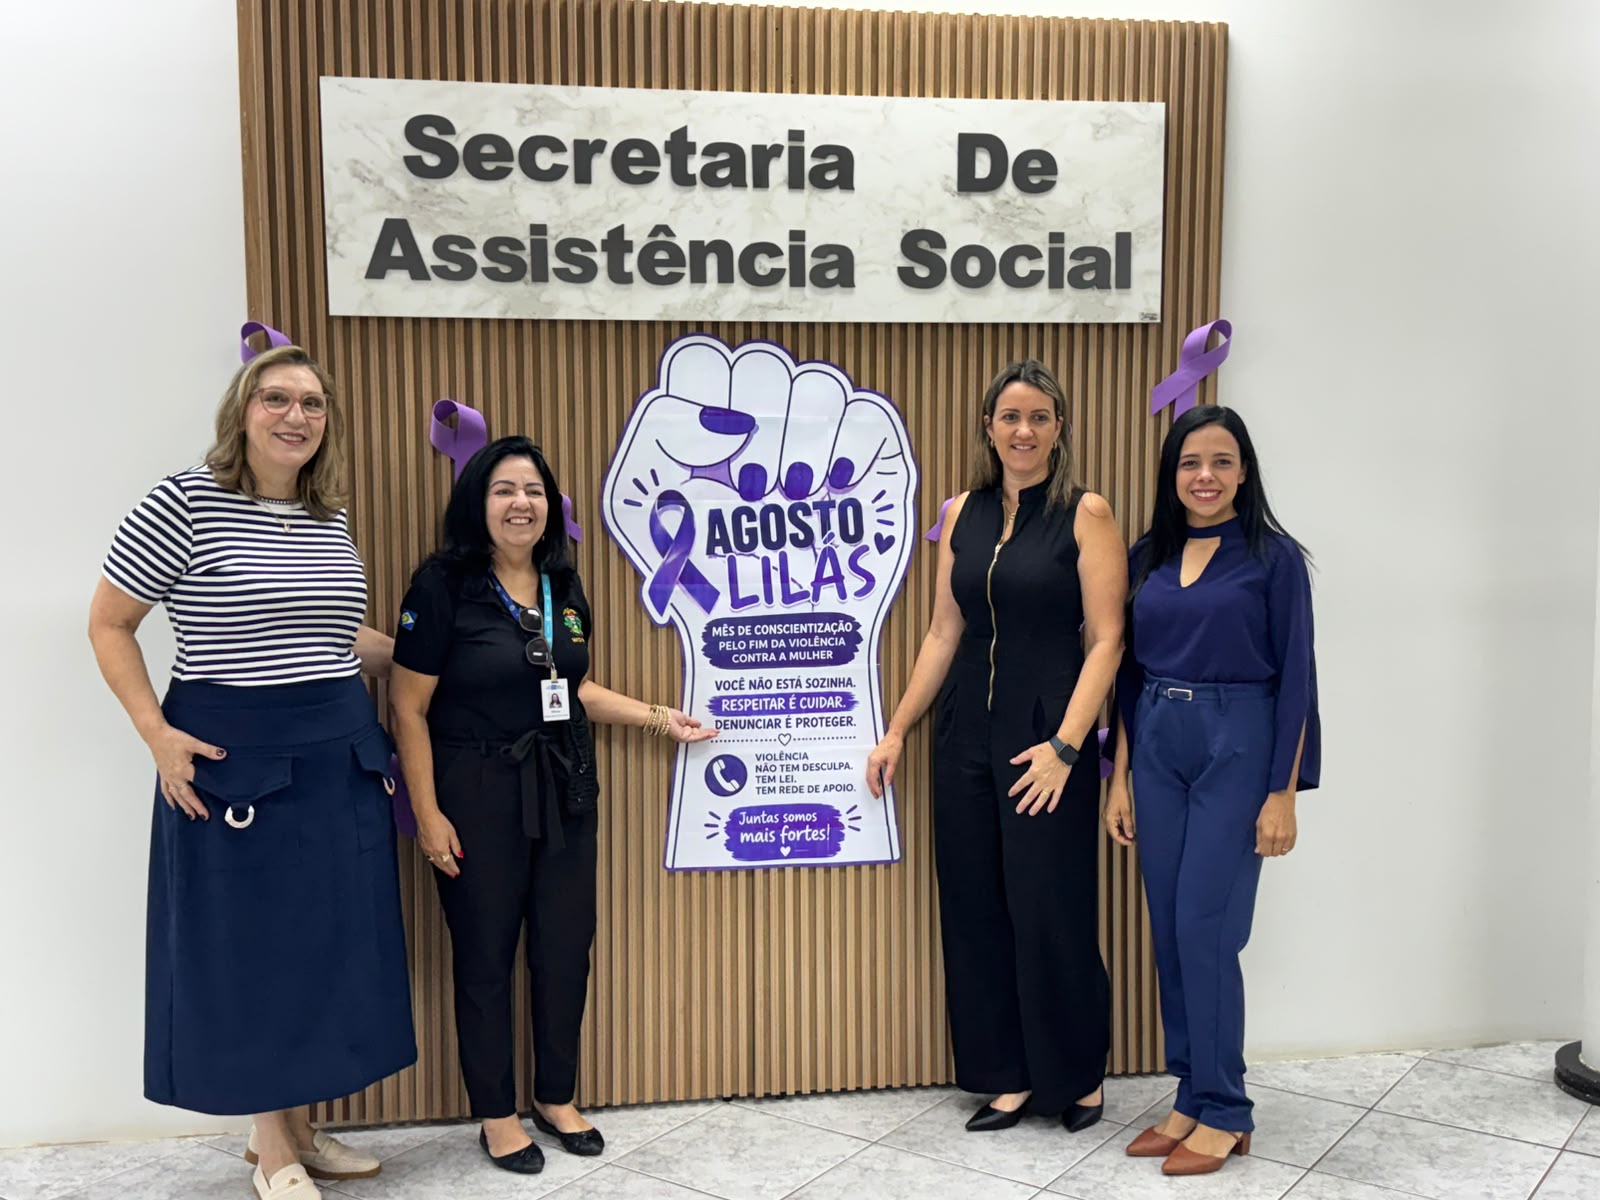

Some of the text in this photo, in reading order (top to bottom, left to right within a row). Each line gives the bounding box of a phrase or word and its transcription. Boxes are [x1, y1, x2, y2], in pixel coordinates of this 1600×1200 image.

[403, 114, 1059, 194] Secretaria De
[364, 218, 1133, 291] Assistência Social
[706, 498, 864, 555] AGOSTO
[727, 532, 876, 609] LILÁS
[712, 620, 852, 637] MÊS DE CONSCIENTIZAÇÃO
[719, 635, 846, 650] PELO FIM DA VIOLÊNCIA
[732, 651, 833, 663] CONTRA A MULHER
[715, 676, 856, 691] VOCÊ NÃO ESTÁ SOZINHA.
[722, 695, 846, 712] RESPEITAR É CUIDAR.
[715, 715, 856, 730] DENUNCIAR É PROTEGER.
[755, 751, 809, 761] VIOLÊNCIA
[755, 762, 853, 772] NÃO TEM DESCULPA.
[755, 775, 797, 784] TEM LEI.
[755, 784, 856, 794] TEM REDE DE APOIO.
[739, 810, 817, 825] Juntas somos
[740, 824, 830, 844] mais fortes!
